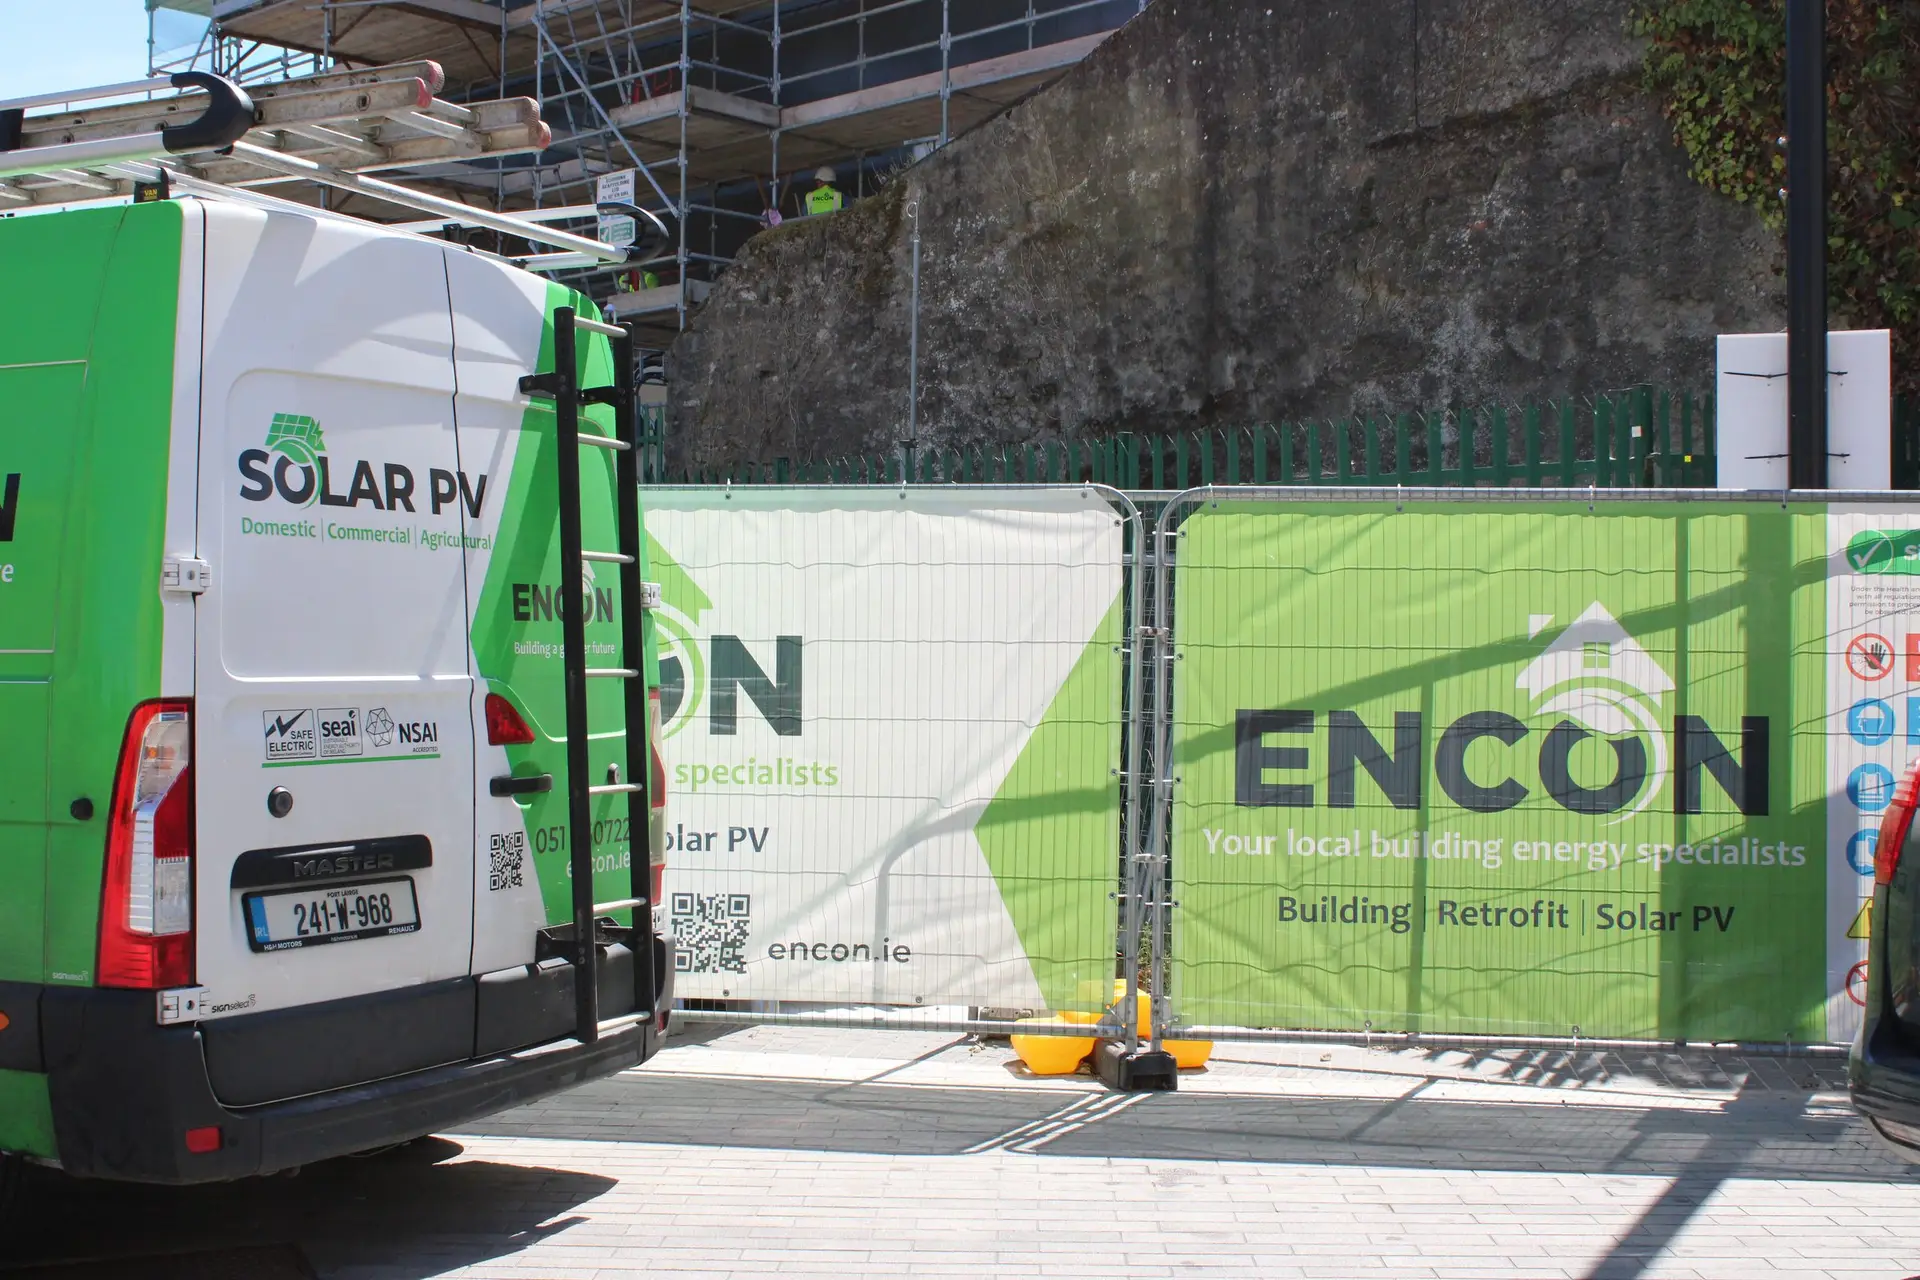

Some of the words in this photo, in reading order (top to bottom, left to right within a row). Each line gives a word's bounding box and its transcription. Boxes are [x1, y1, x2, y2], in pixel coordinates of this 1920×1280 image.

[238, 448, 416, 513] SOLAR
[430, 468, 487, 519] PV
[241, 517, 316, 539] Domestic
[327, 522, 411, 545] Commercial
[420, 528, 492, 551] Agricultural
[514, 641, 551, 659] Building
[592, 641, 616, 654] future
[290, 730, 313, 740] SAFE
[321, 710, 357, 738] seai
[399, 722, 438, 743] NSAI
[269, 741, 314, 752] ELECTRIC
[675, 757, 839, 792] specialists
[1235, 708, 1770, 817] ENCON
[535, 825, 565, 854] 051
[728, 826, 770, 852] PV
[1202, 828, 1278, 856] Your
[1287, 828, 1360, 857] local
[1371, 829, 1504, 869] building
[1512, 838, 1627, 872] energy
[1637, 836, 1806, 872] specialists
[294, 853, 394, 878] MASTER
[294, 893, 393, 936] 241-W-968
[1278, 895, 1412, 934] Building
[1438, 899, 1569, 929] Retrofit
[1596, 902, 1682, 931] Solar
[1692, 905, 1735, 932] PV
[255, 926, 268, 937] IRL
[388, 925, 415, 935] RENAULT
[277, 940, 303, 950] MOTORS
[768, 937, 911, 964] encon.ie
